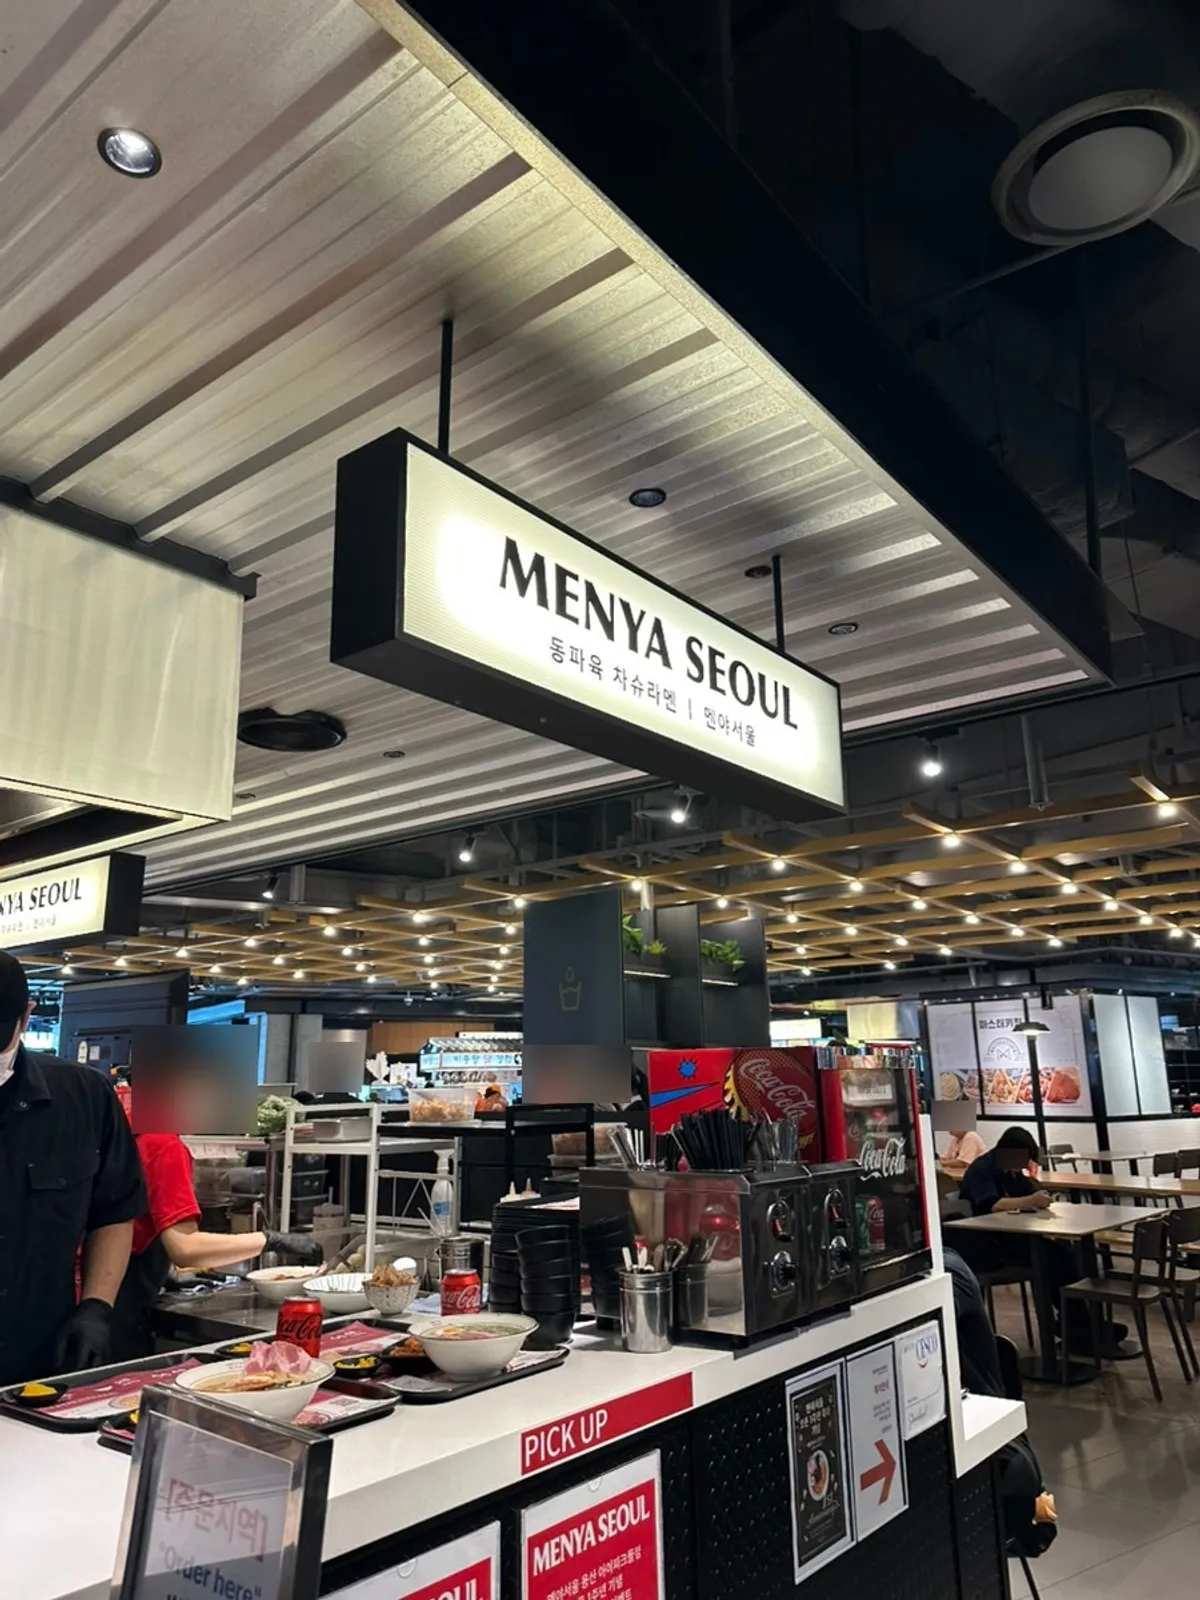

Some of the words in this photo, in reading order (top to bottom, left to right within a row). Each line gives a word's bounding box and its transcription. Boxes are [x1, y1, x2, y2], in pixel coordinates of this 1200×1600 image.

[500, 536, 672, 670] MENYA
[686, 636, 798, 730] SEOUL
[549, 636, 604, 681] 동파육
[613, 666, 676, 714] 차슈라멘
[704, 707, 755, 747] 멘야서울
[29, 878, 82, 911] SEOUL
[525, 1420, 575, 1467] PICK
[581, 1409, 608, 1444] UP
[533, 1521, 596, 1576] MENYA
[598, 1495, 650, 1542] SEOUL
